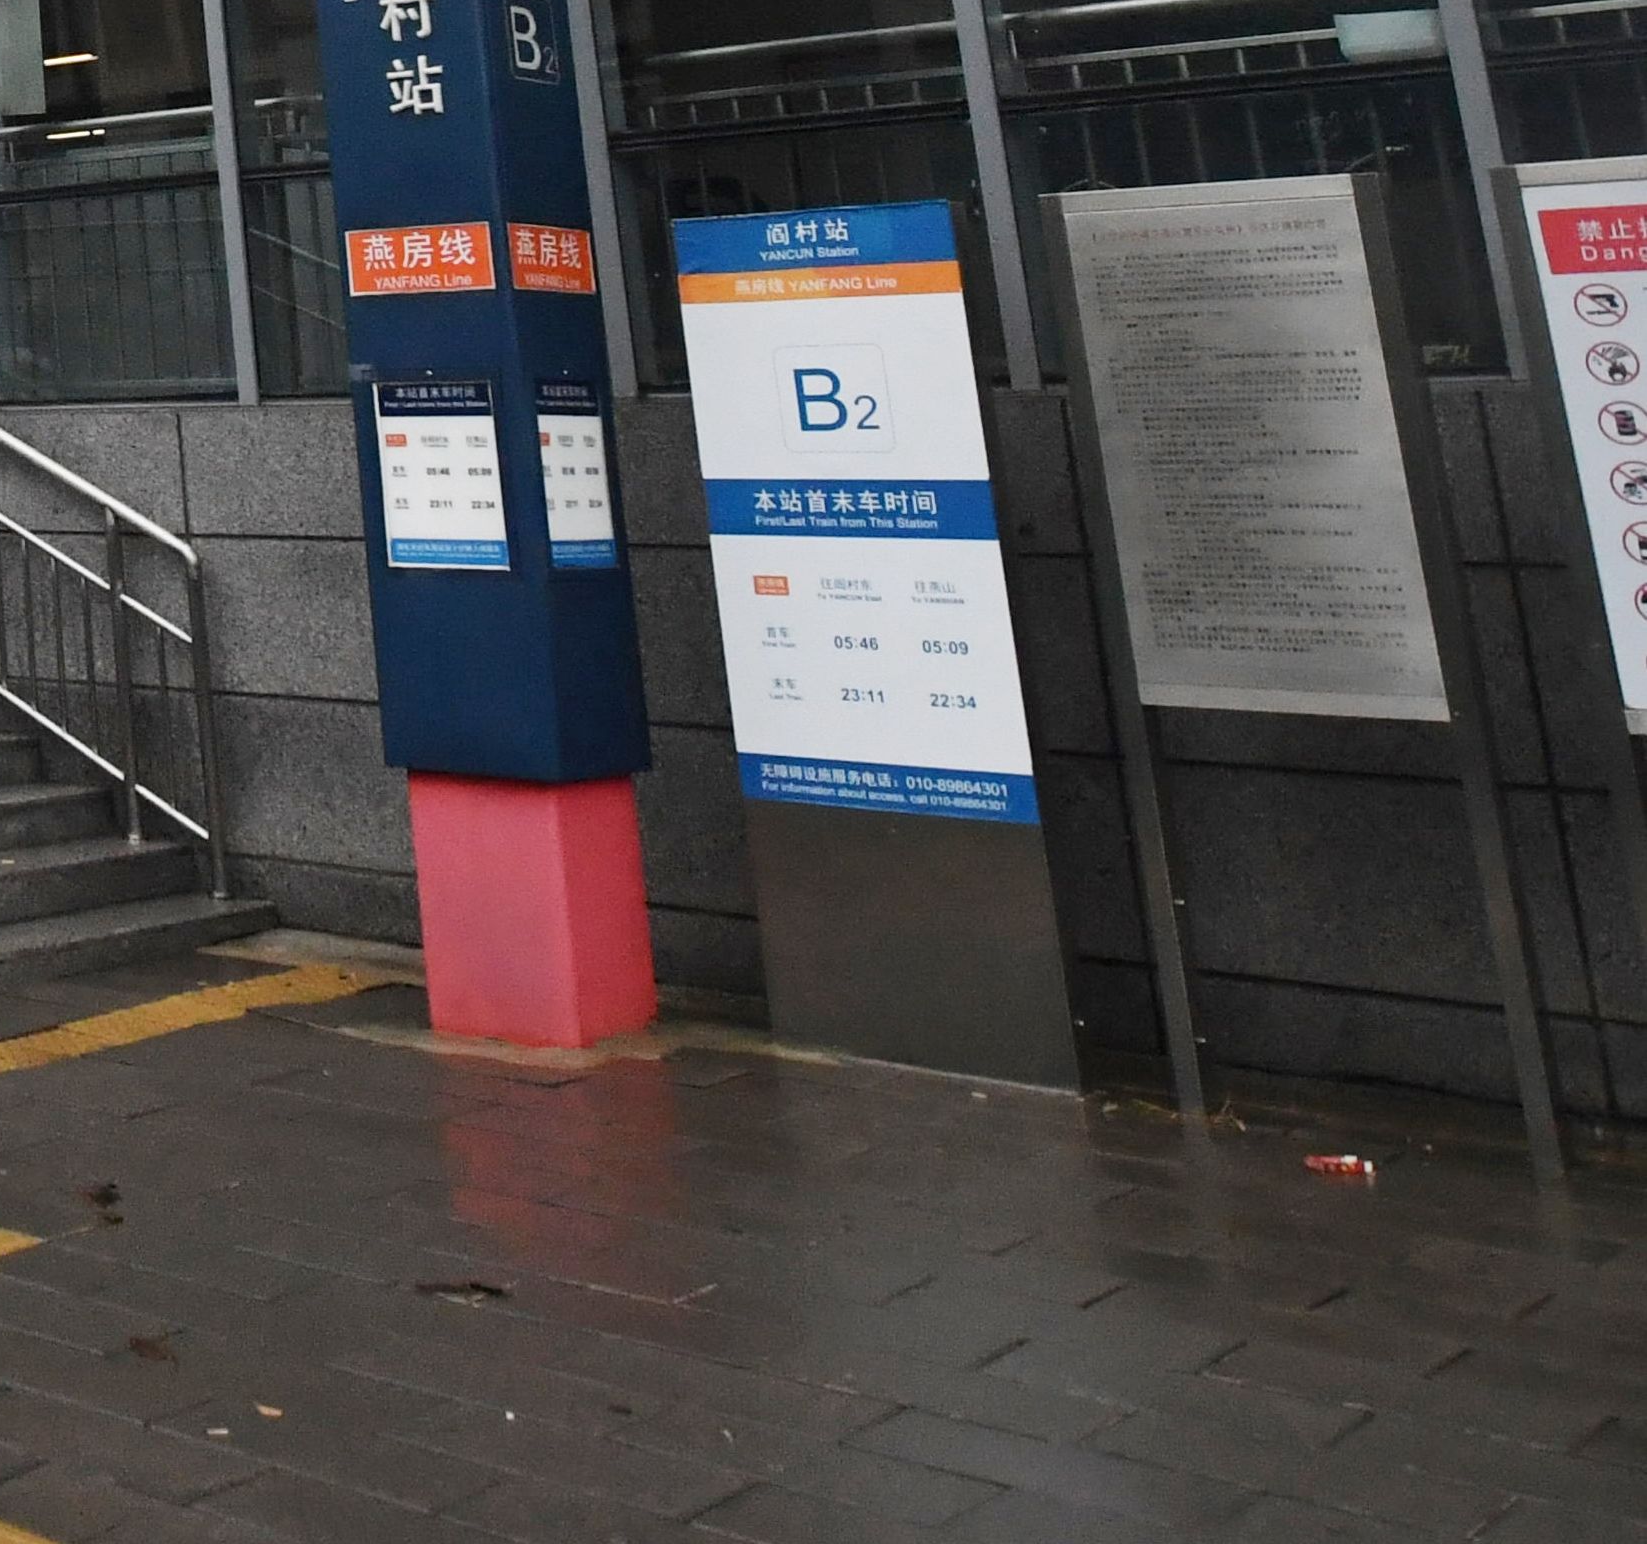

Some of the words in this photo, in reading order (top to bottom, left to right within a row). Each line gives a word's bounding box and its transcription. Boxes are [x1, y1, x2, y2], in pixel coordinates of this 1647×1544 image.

[510, 5, 559, 74] B2
[766, 218, 849, 246] 阎村站
[362, 229, 476, 271] 燕房线
[515, 229, 582, 269] 燕房线
[760, 249, 814, 262] YANCUN
[817, 246, 859, 258] Station
[374, 273, 441, 290] YANFANG
[444, 271, 473, 287] Line
[524, 273, 564, 289] YANFANG
[788, 277, 862, 293] YANFANG
[866, 276, 898, 289] Line
[793, 368, 880, 431] B2
[753, 488, 937, 515] 本站首末车时间
[809, 516, 837, 527] Train
[839, 516, 866, 529] from
[868, 517, 894, 529] This
[896, 517, 938, 529] Station
[833, 635, 879, 651] 05:46
[922, 639, 969, 655] 05:09
[841, 687, 885, 703] 23:11
[930, 693, 977, 708] 22:34
